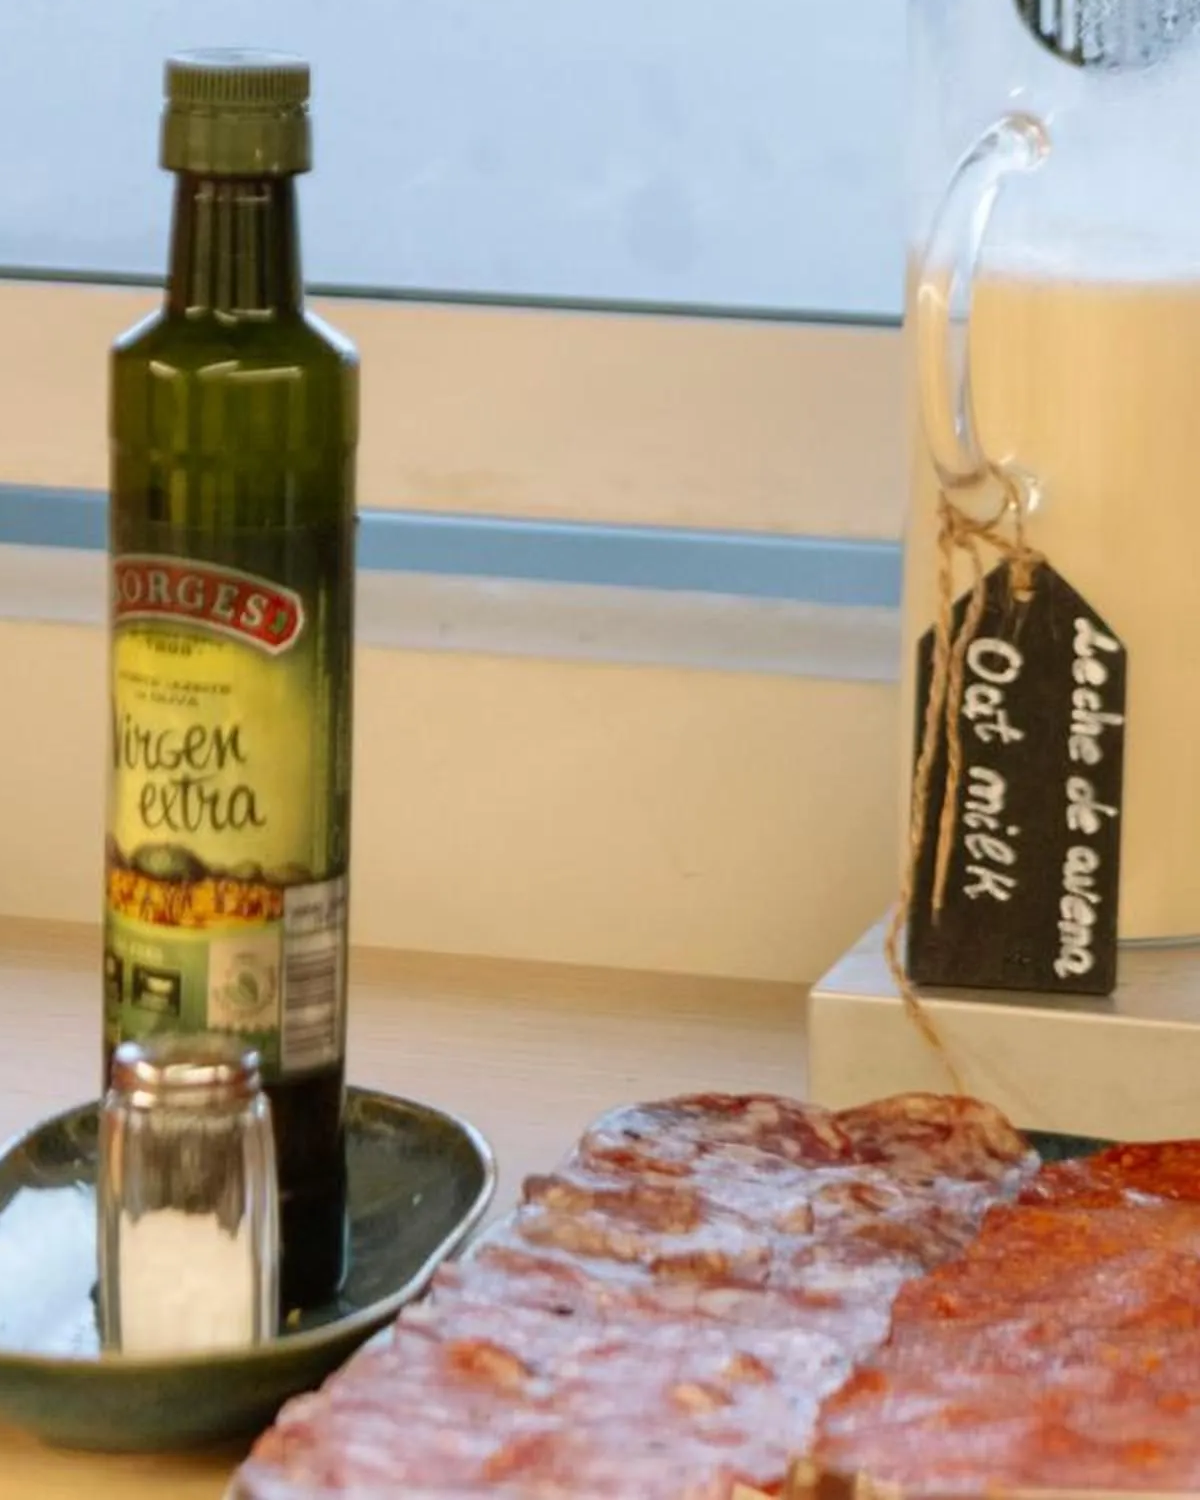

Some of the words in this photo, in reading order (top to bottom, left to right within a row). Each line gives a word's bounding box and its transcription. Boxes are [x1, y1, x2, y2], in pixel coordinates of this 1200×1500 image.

[116, 568, 267, 626] ORGES
[963, 637, 1023, 743] Oat
[1068, 616, 1124, 766] Leche
[113, 712, 246, 770] irgen
[139, 774, 266, 832] extra
[962, 765, 1021, 902] milk
[1066, 776, 1119, 835] de
[1053, 845, 1100, 978] avena
